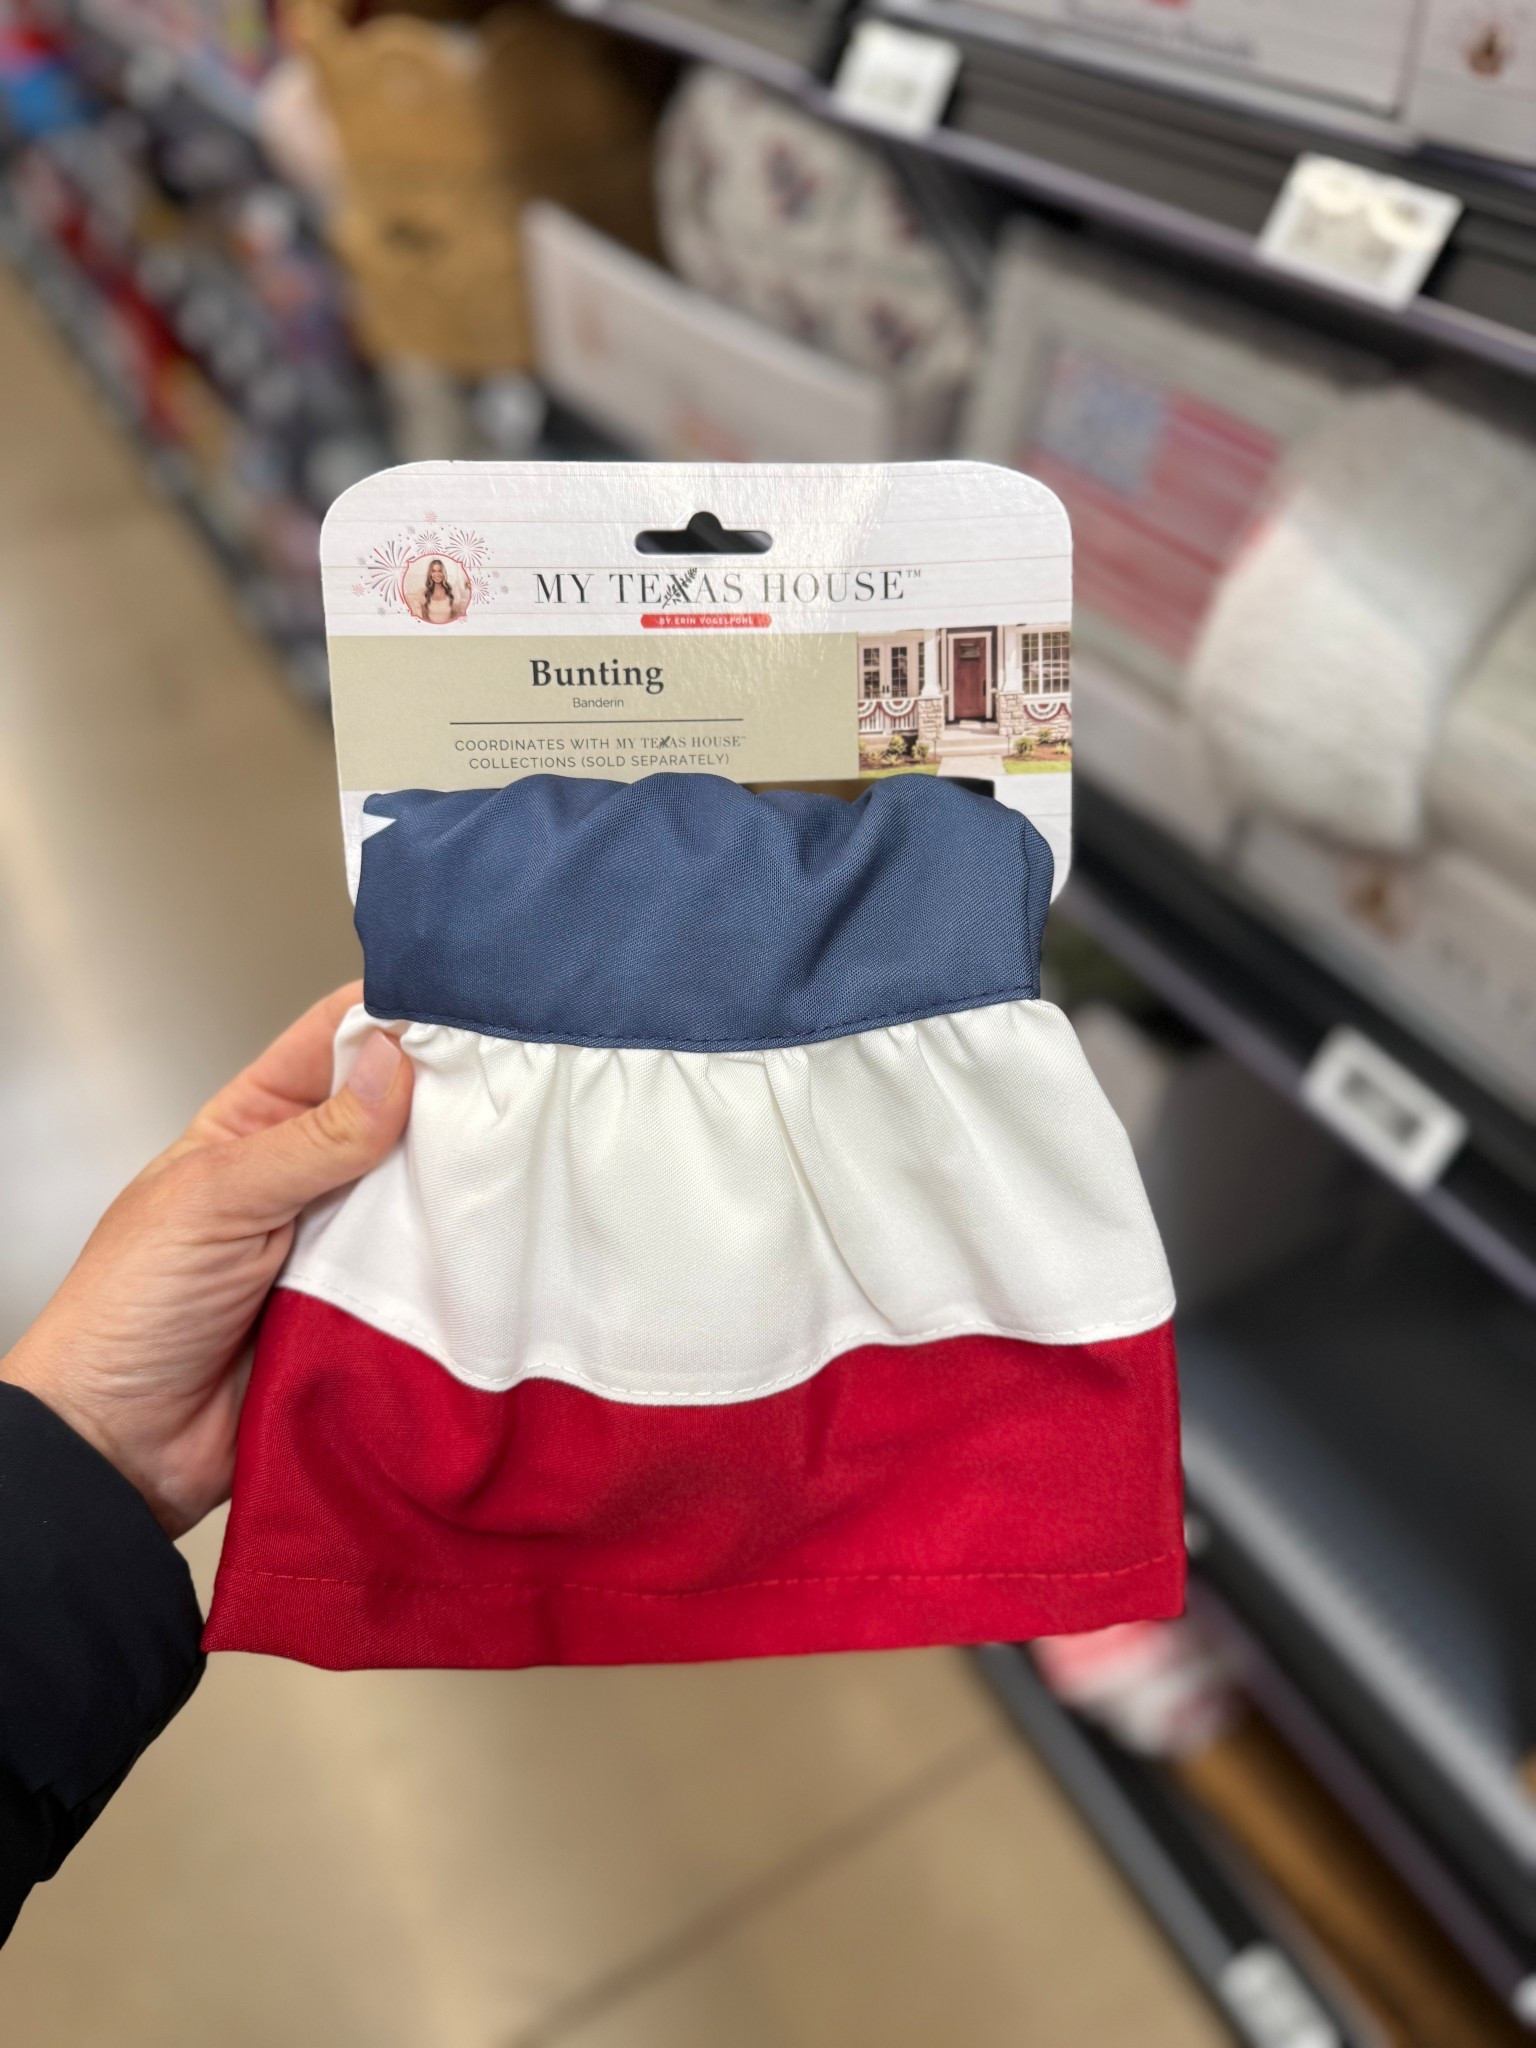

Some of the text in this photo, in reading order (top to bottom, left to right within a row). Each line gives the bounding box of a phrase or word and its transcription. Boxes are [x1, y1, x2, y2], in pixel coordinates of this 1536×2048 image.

[533, 573, 595, 604] MY
[609, 567, 744, 609] TEXAS
[658, 617, 753, 625] BY ERIN VOGELPOHL
[529, 658, 664, 695] Bunting
[572, 697, 624, 708] Banderin
[455, 739, 565, 751] COORDINATES
[570, 738, 609, 750] WITH
[616, 738, 635, 749] MY
[640, 735, 687, 750] TEXAS
[469, 754, 729, 769] COLLECTIONS (SOLD SEPARATELY)
